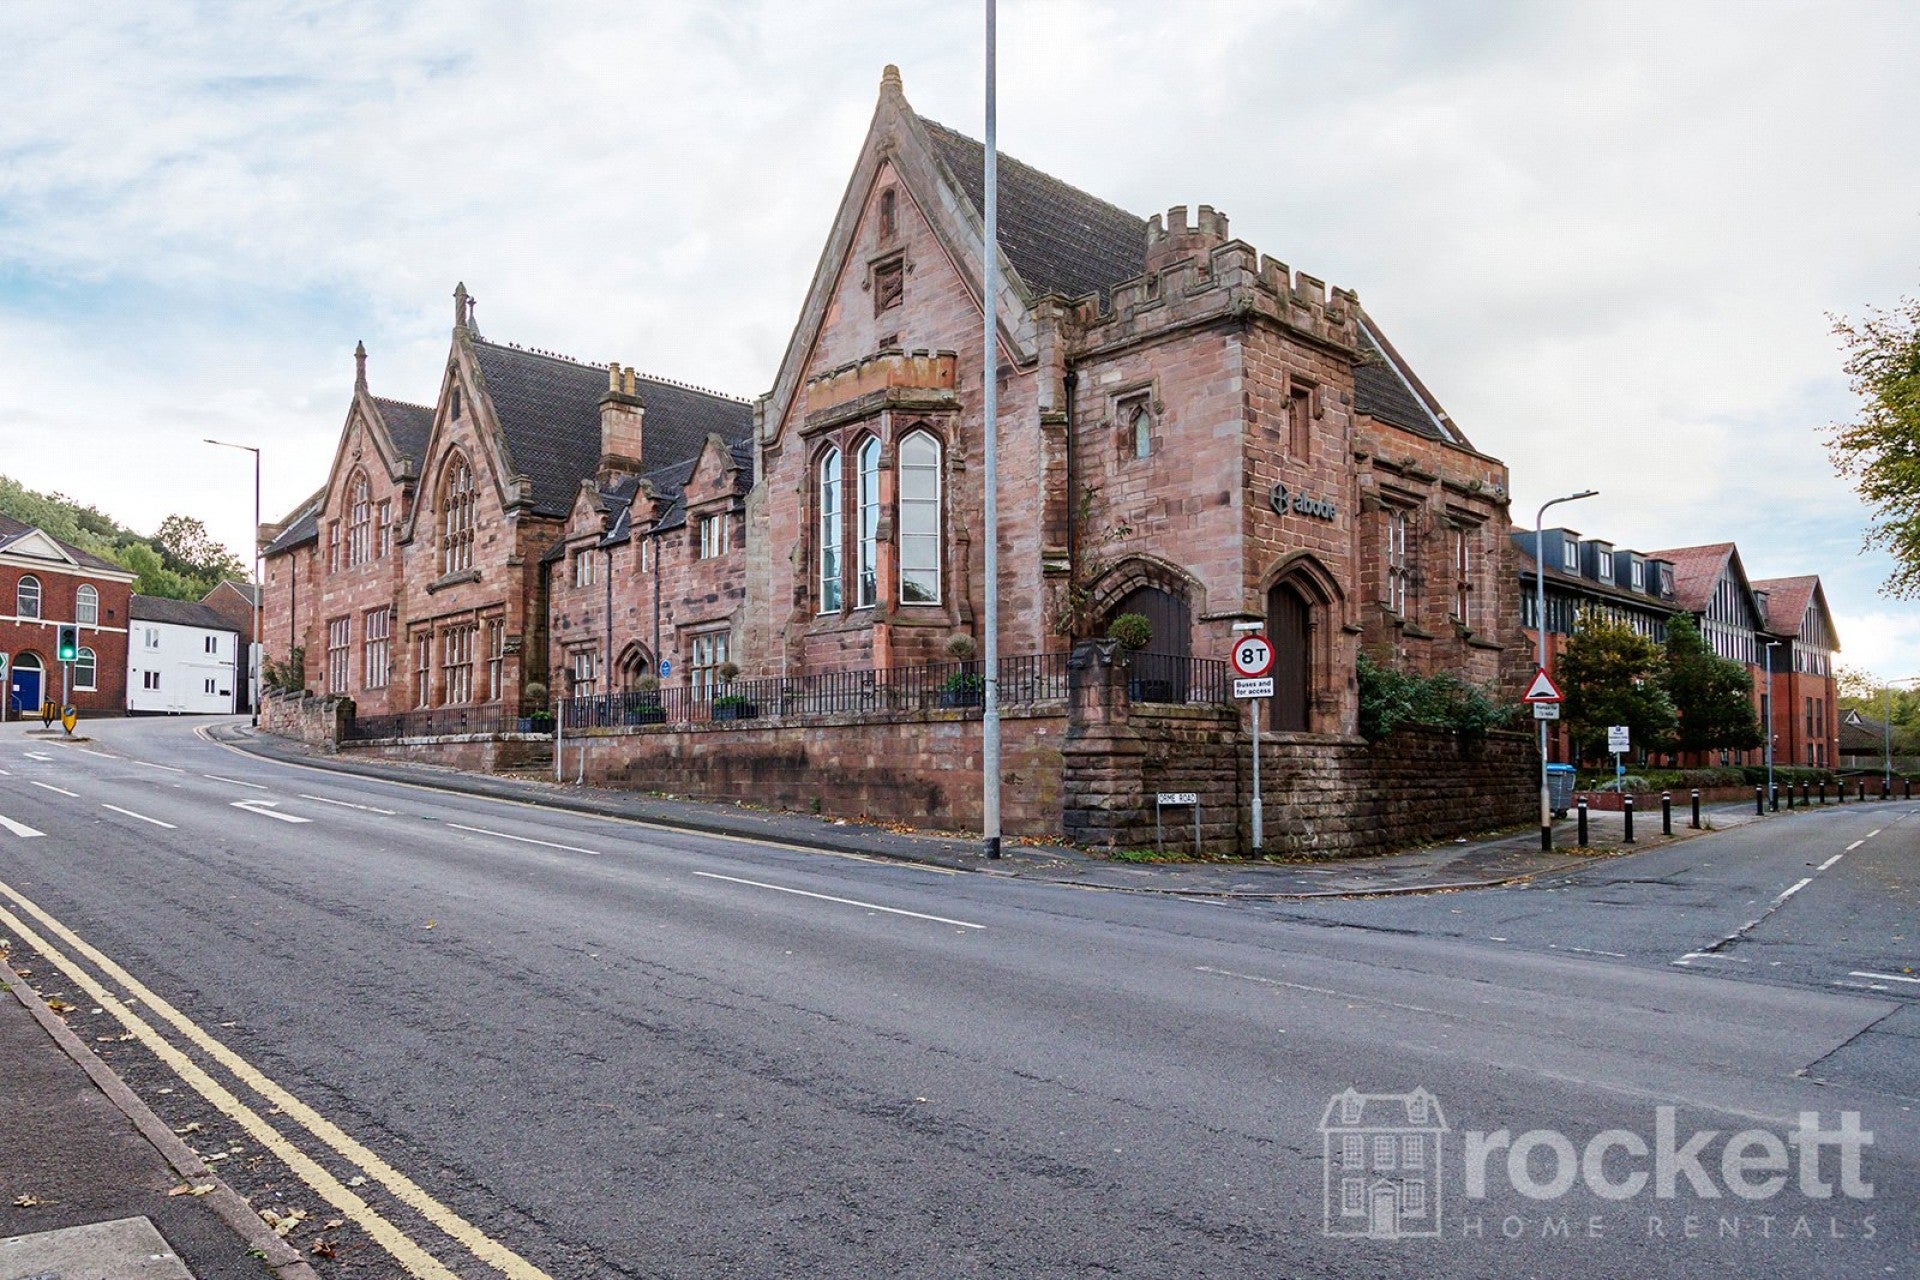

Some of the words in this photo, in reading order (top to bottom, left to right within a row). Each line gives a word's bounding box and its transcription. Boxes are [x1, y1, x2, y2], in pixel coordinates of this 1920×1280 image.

[1292, 489, 1338, 520] abode
[1159, 794, 1176, 803] ORME
[1179, 794, 1195, 803] ROAD
